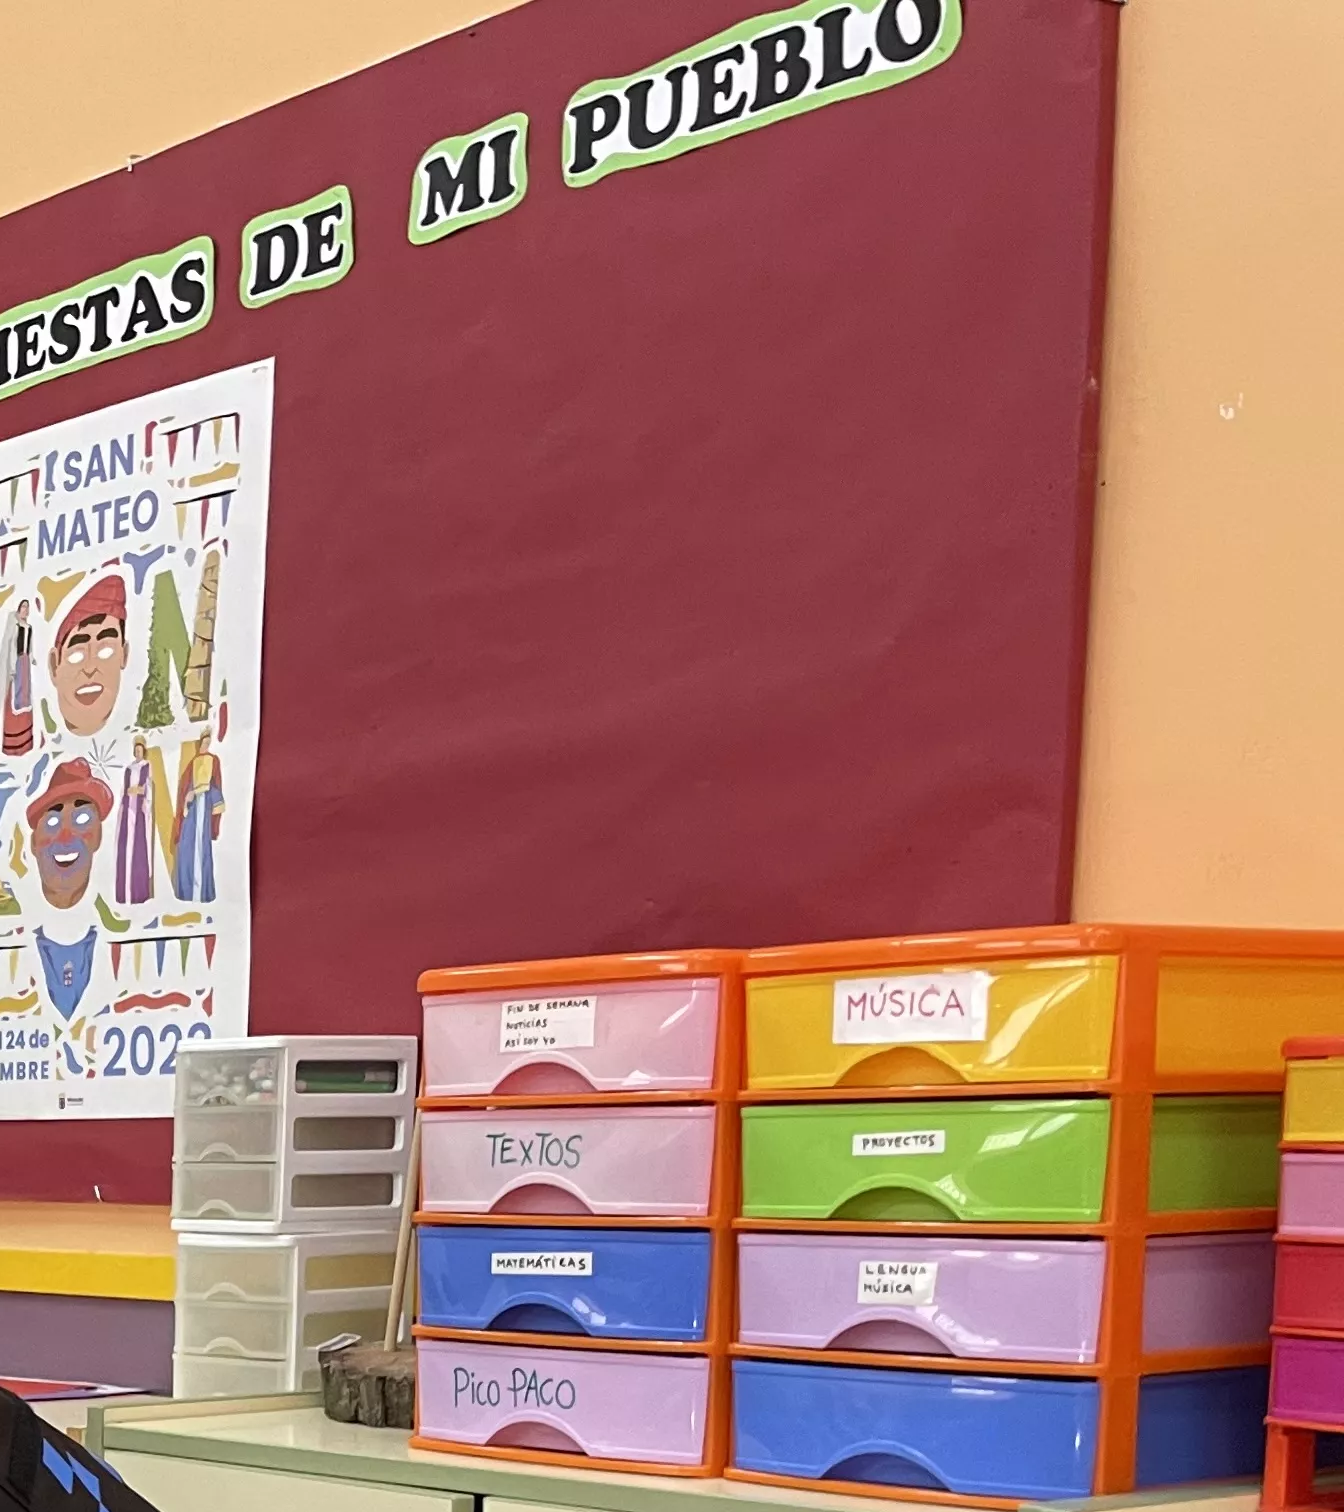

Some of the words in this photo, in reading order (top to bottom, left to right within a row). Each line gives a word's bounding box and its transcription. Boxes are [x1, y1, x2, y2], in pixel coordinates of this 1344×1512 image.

[249, 203, 344, 297] DE
[419, 129, 518, 226] MI
[566, 0, 943, 174] PUEBLO
[63, 433, 135, 492] SAN
[37, 490, 159, 560] MATEO
[507, 1004, 524, 1015] FIN
[528, 1002, 540, 1012] DE
[546, 999, 590, 1010] SEMANA
[847, 982, 965, 1022] MÚSICA
[5, 1030, 26, 1050] 24
[28, 1028, 50, 1049] de
[523, 1037, 539, 1046] SOY
[543, 1036, 556, 1046] YO
[486, 1132, 583, 1169] TEXTOS
[862, 1133, 937, 1151] PROYECTOS
[496, 1254, 586, 1271] MATEMÁTICAS
[865, 1263, 927, 1276] LENGUA
[863, 1278, 913, 1295] MÚSICA
